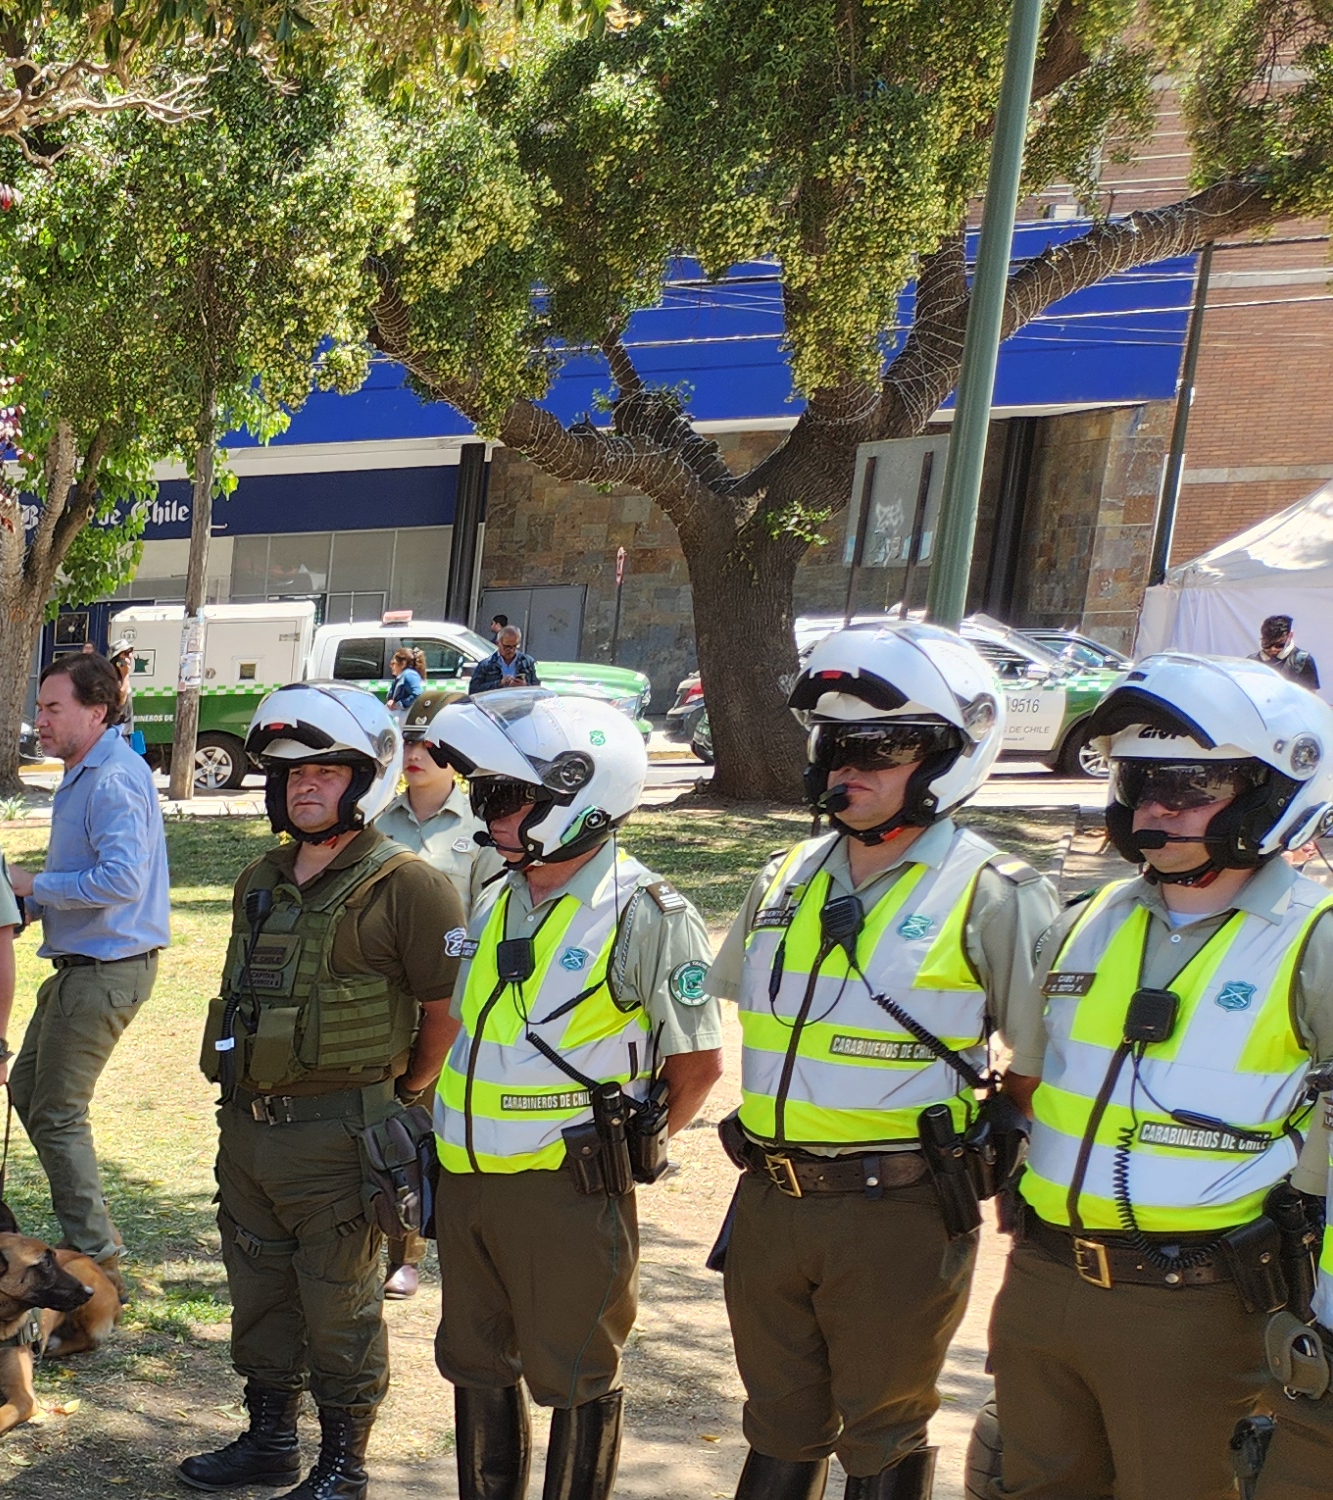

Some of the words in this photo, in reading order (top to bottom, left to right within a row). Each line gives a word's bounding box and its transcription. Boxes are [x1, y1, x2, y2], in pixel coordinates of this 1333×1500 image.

[130, 499, 190, 526] Chile
[1023, 726, 1050, 734] CHILE
[833, 1037, 900, 1058] CARABINEROS
[900, 1044, 912, 1059] DE
[503, 1096, 558, 1109] CARABINEROS
[559, 1094, 571, 1107] DE
[573, 1091, 593, 1106] CHIL
[1140, 1124, 1220, 1149] CARABINEROS
[1220, 1133, 1235, 1150] DE
